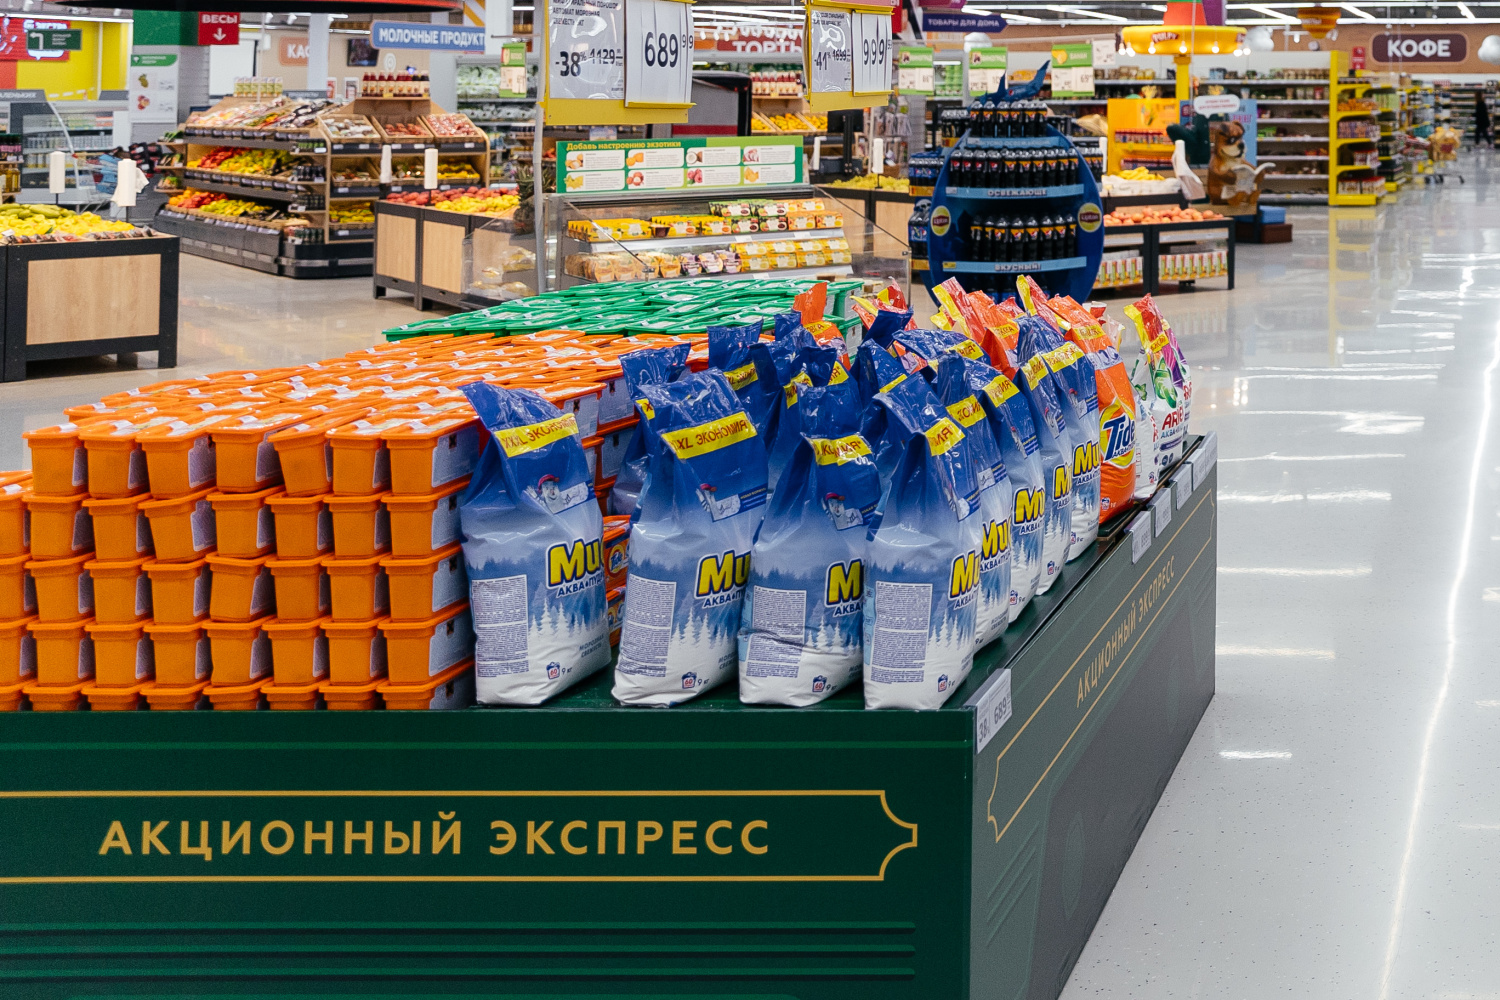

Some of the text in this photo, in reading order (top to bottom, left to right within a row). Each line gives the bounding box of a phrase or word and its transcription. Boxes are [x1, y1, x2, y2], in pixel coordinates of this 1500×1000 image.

[202, 14, 238, 24] ВЕСЫ
[379, 27, 485, 47] МОЛОЧНЫЕ ПРОДУКТ
[644, 31, 679, 68] 689
[863, 38, 885, 66] 999
[1387, 39, 1451, 58] КОФЕ
[566, 140, 681, 151] Добавь настроению экзотики
[1161, 406, 1184, 431] ARIE
[1102, 413, 1136, 462] Tide
[1073, 440, 1100, 477] Ми
[1014, 487, 1046, 525] Ми
[982, 519, 1011, 560] Ми
[549, 541, 603, 586] Ми
[697, 551, 750, 598] Ми
[950, 552, 980, 599] Ми
[1076, 599, 1137, 708] АКЦИОННЫЙ
[1138, 555, 1175, 623] ЭКСПРЕСС
[99, 811, 771, 861] АКЦИОННЫЙ ЭКСПРЕСС
